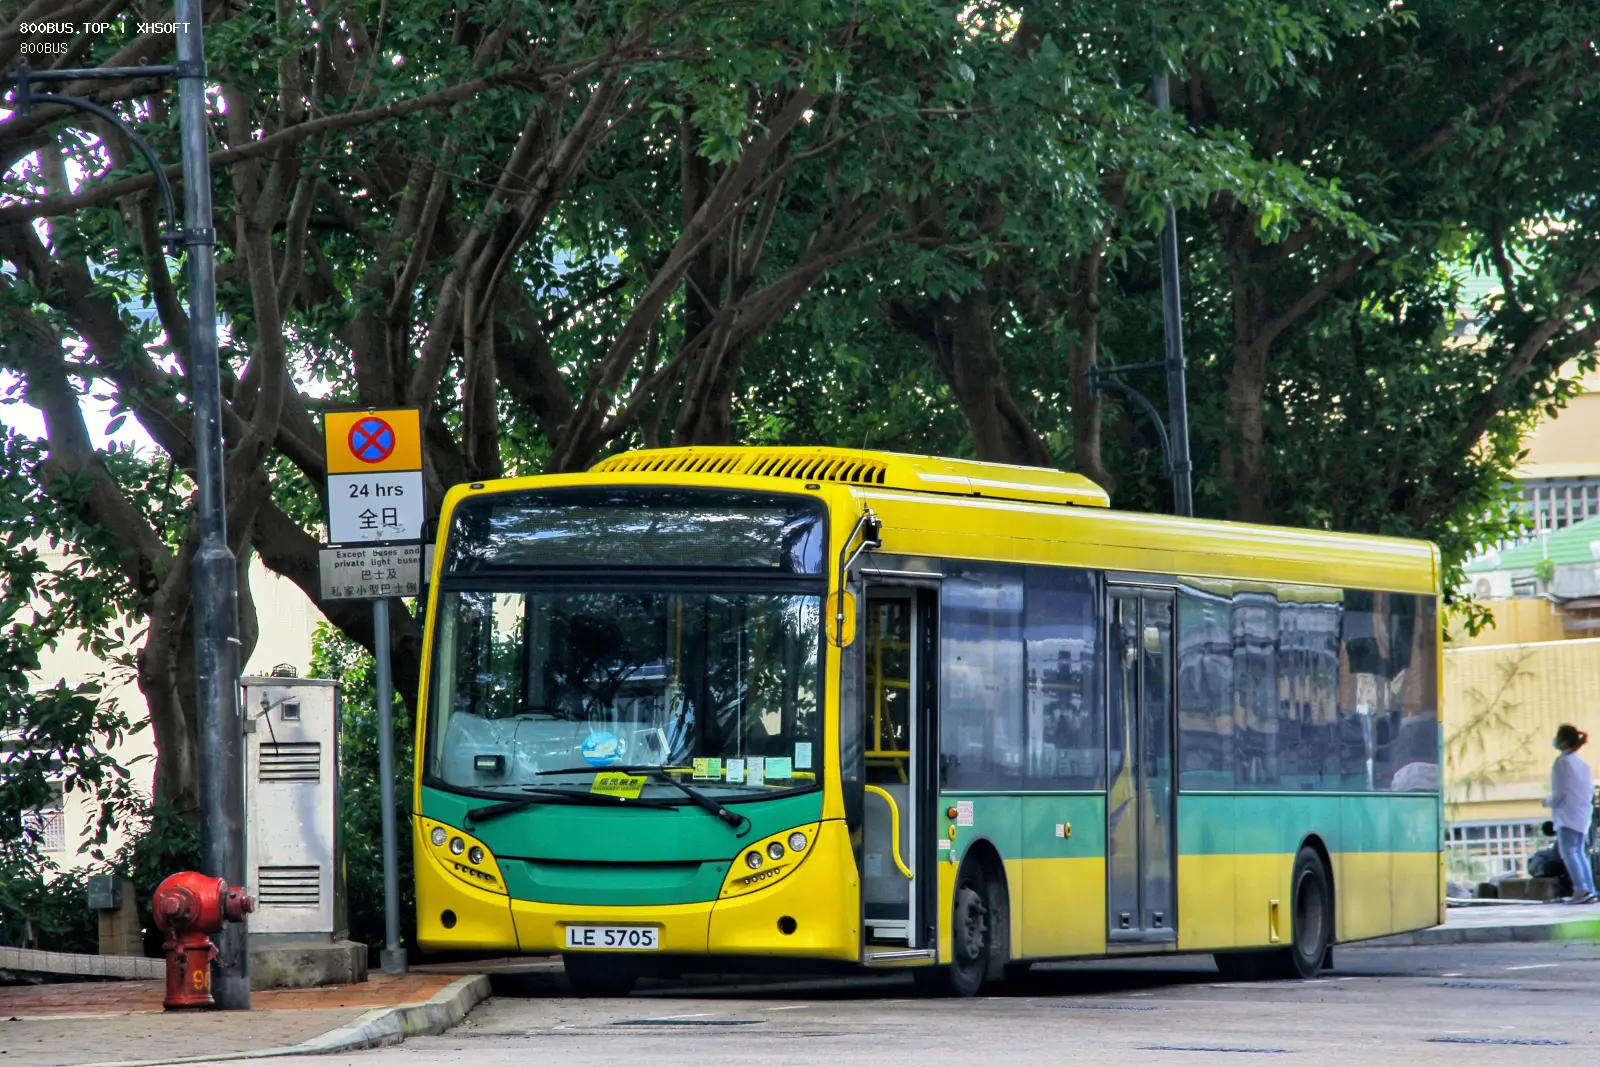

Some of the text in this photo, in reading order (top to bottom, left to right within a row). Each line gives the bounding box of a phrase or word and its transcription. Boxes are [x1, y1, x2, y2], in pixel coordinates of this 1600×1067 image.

[349, 483, 404, 498] 24 hrs
[358, 507, 397, 530] 全日
[336, 547, 420, 559] Except buses and
[334, 559, 365, 568] private
[371, 558, 391, 567] light
[361, 568, 398, 580] 巴士及
[571, 929, 653, 946] LE 5705
